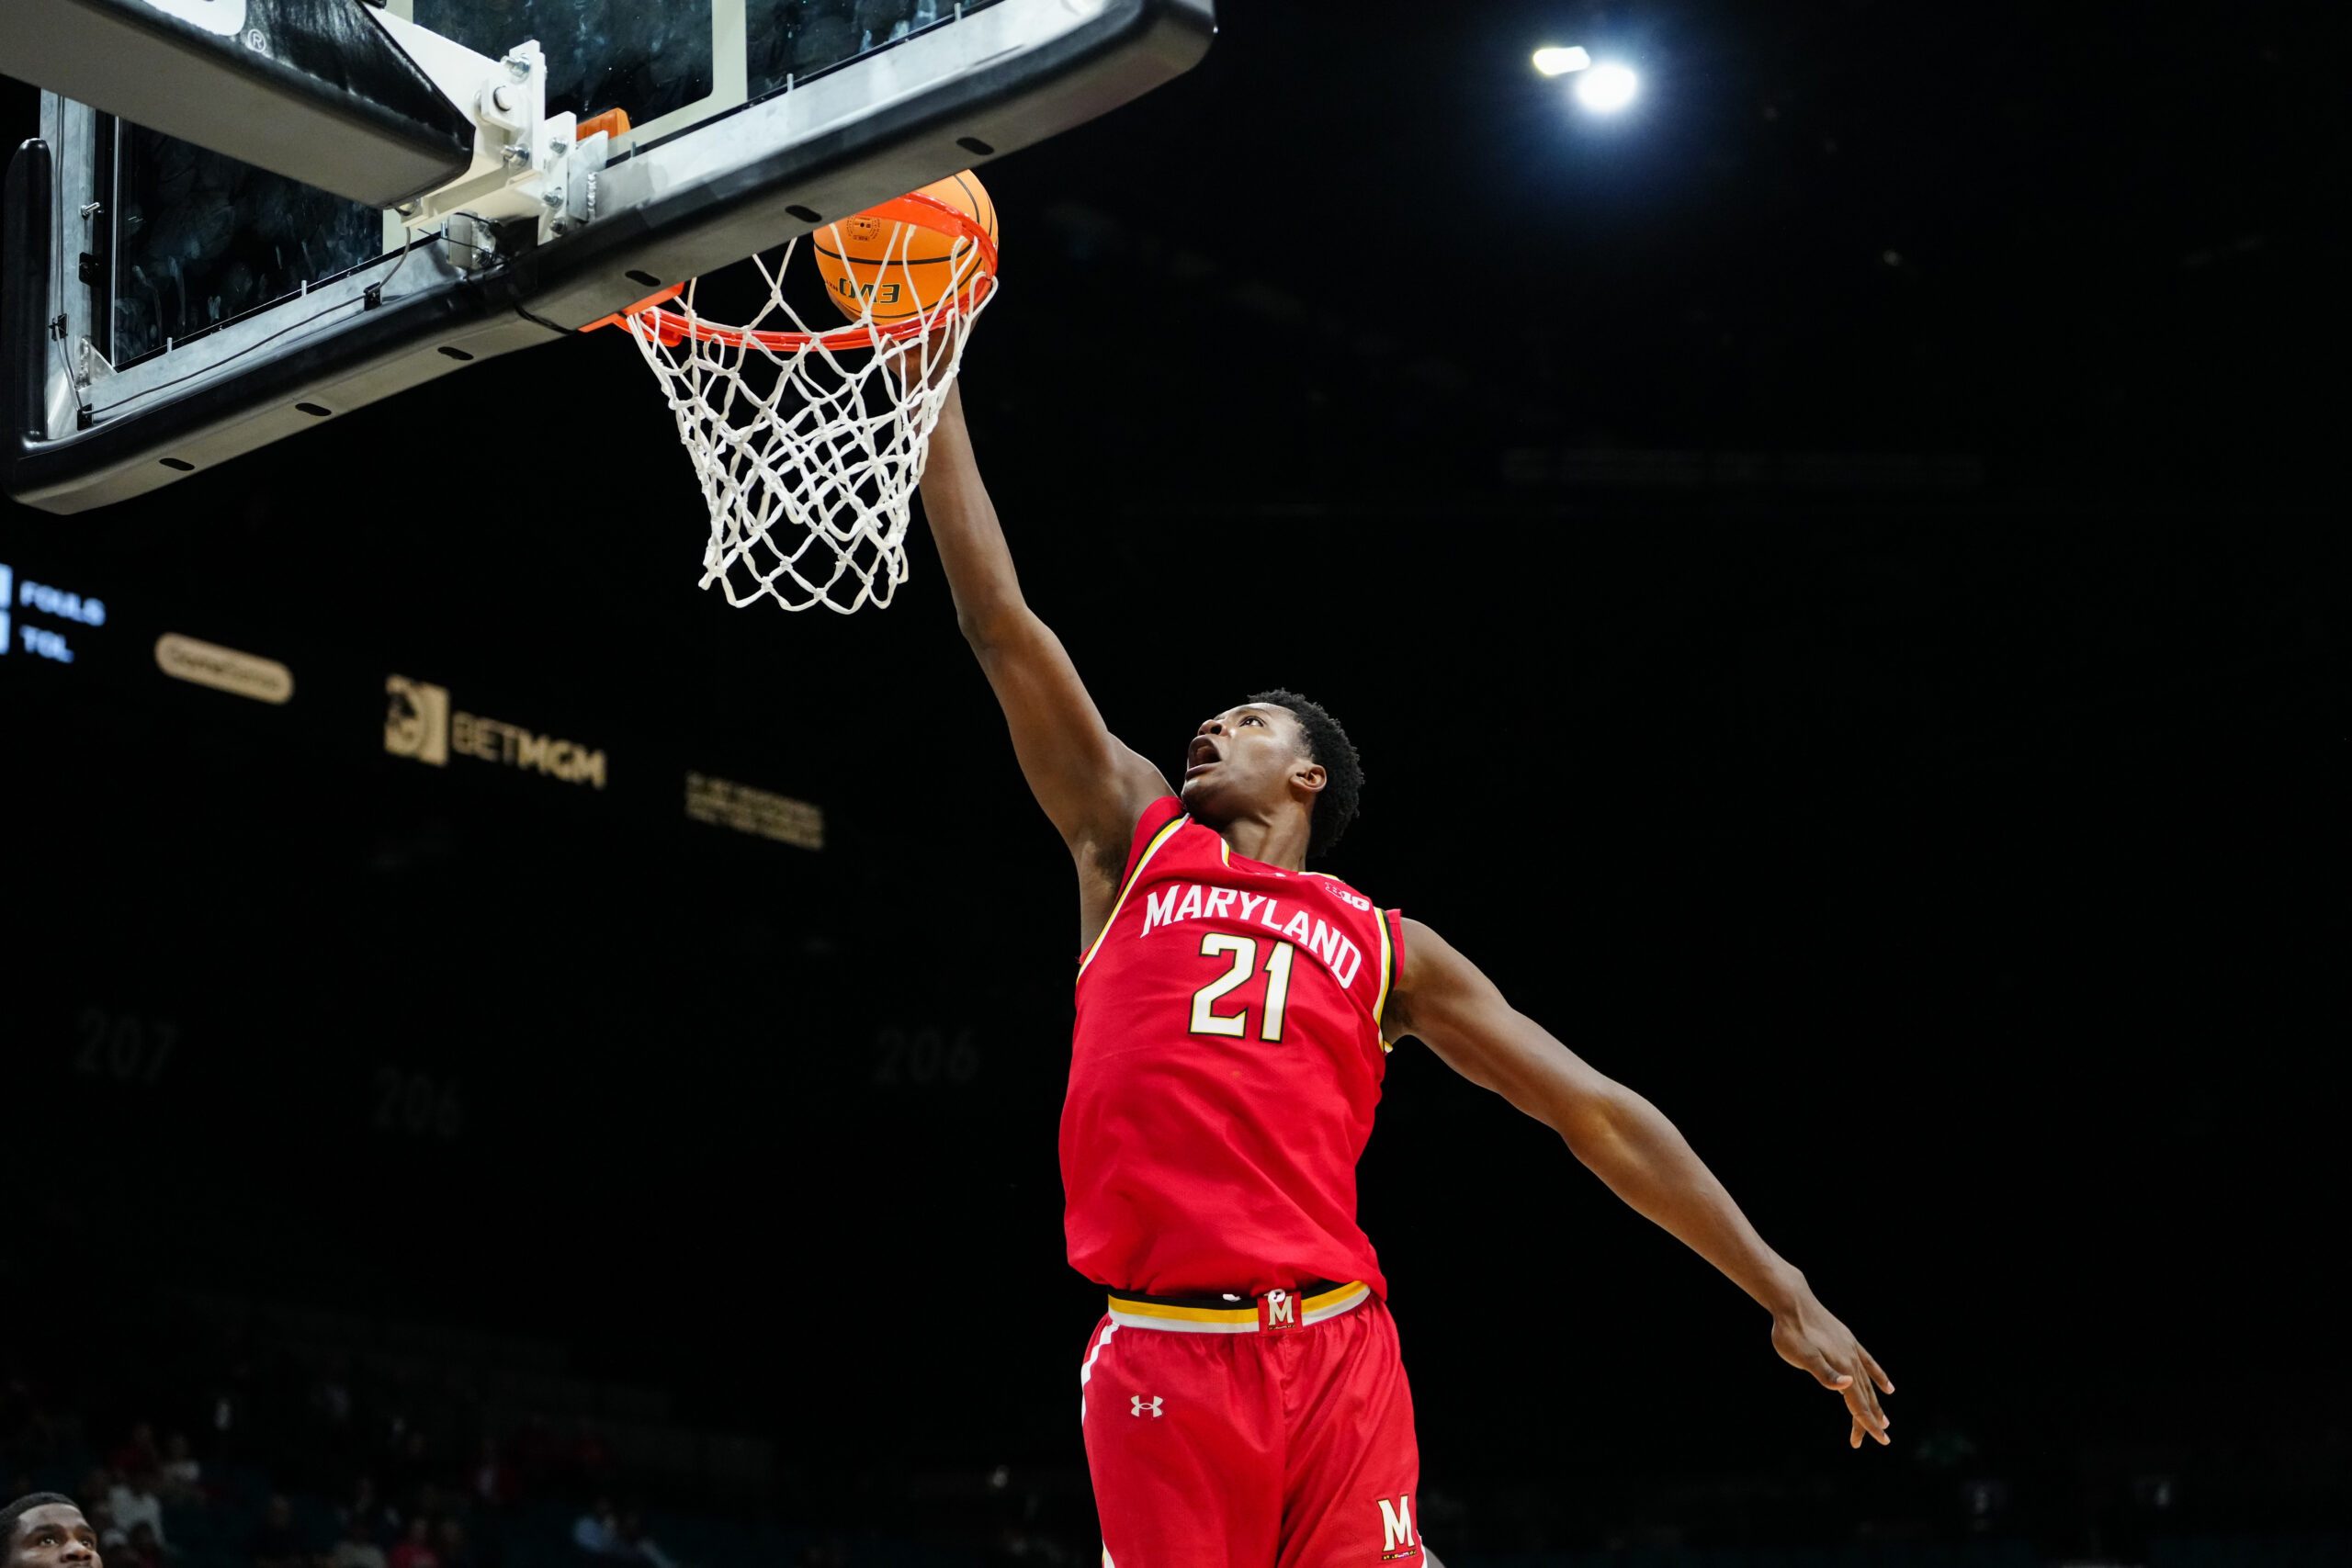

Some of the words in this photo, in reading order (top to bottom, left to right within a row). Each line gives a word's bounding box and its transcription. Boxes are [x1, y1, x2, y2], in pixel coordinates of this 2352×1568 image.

[452, 711, 606, 789] BETMGM
[1140, 884, 1362, 989] MARYLAND
[1188, 932, 1296, 1043] 21
[1265, 1293, 1295, 1326] M
[1376, 1494, 1416, 1552] M
